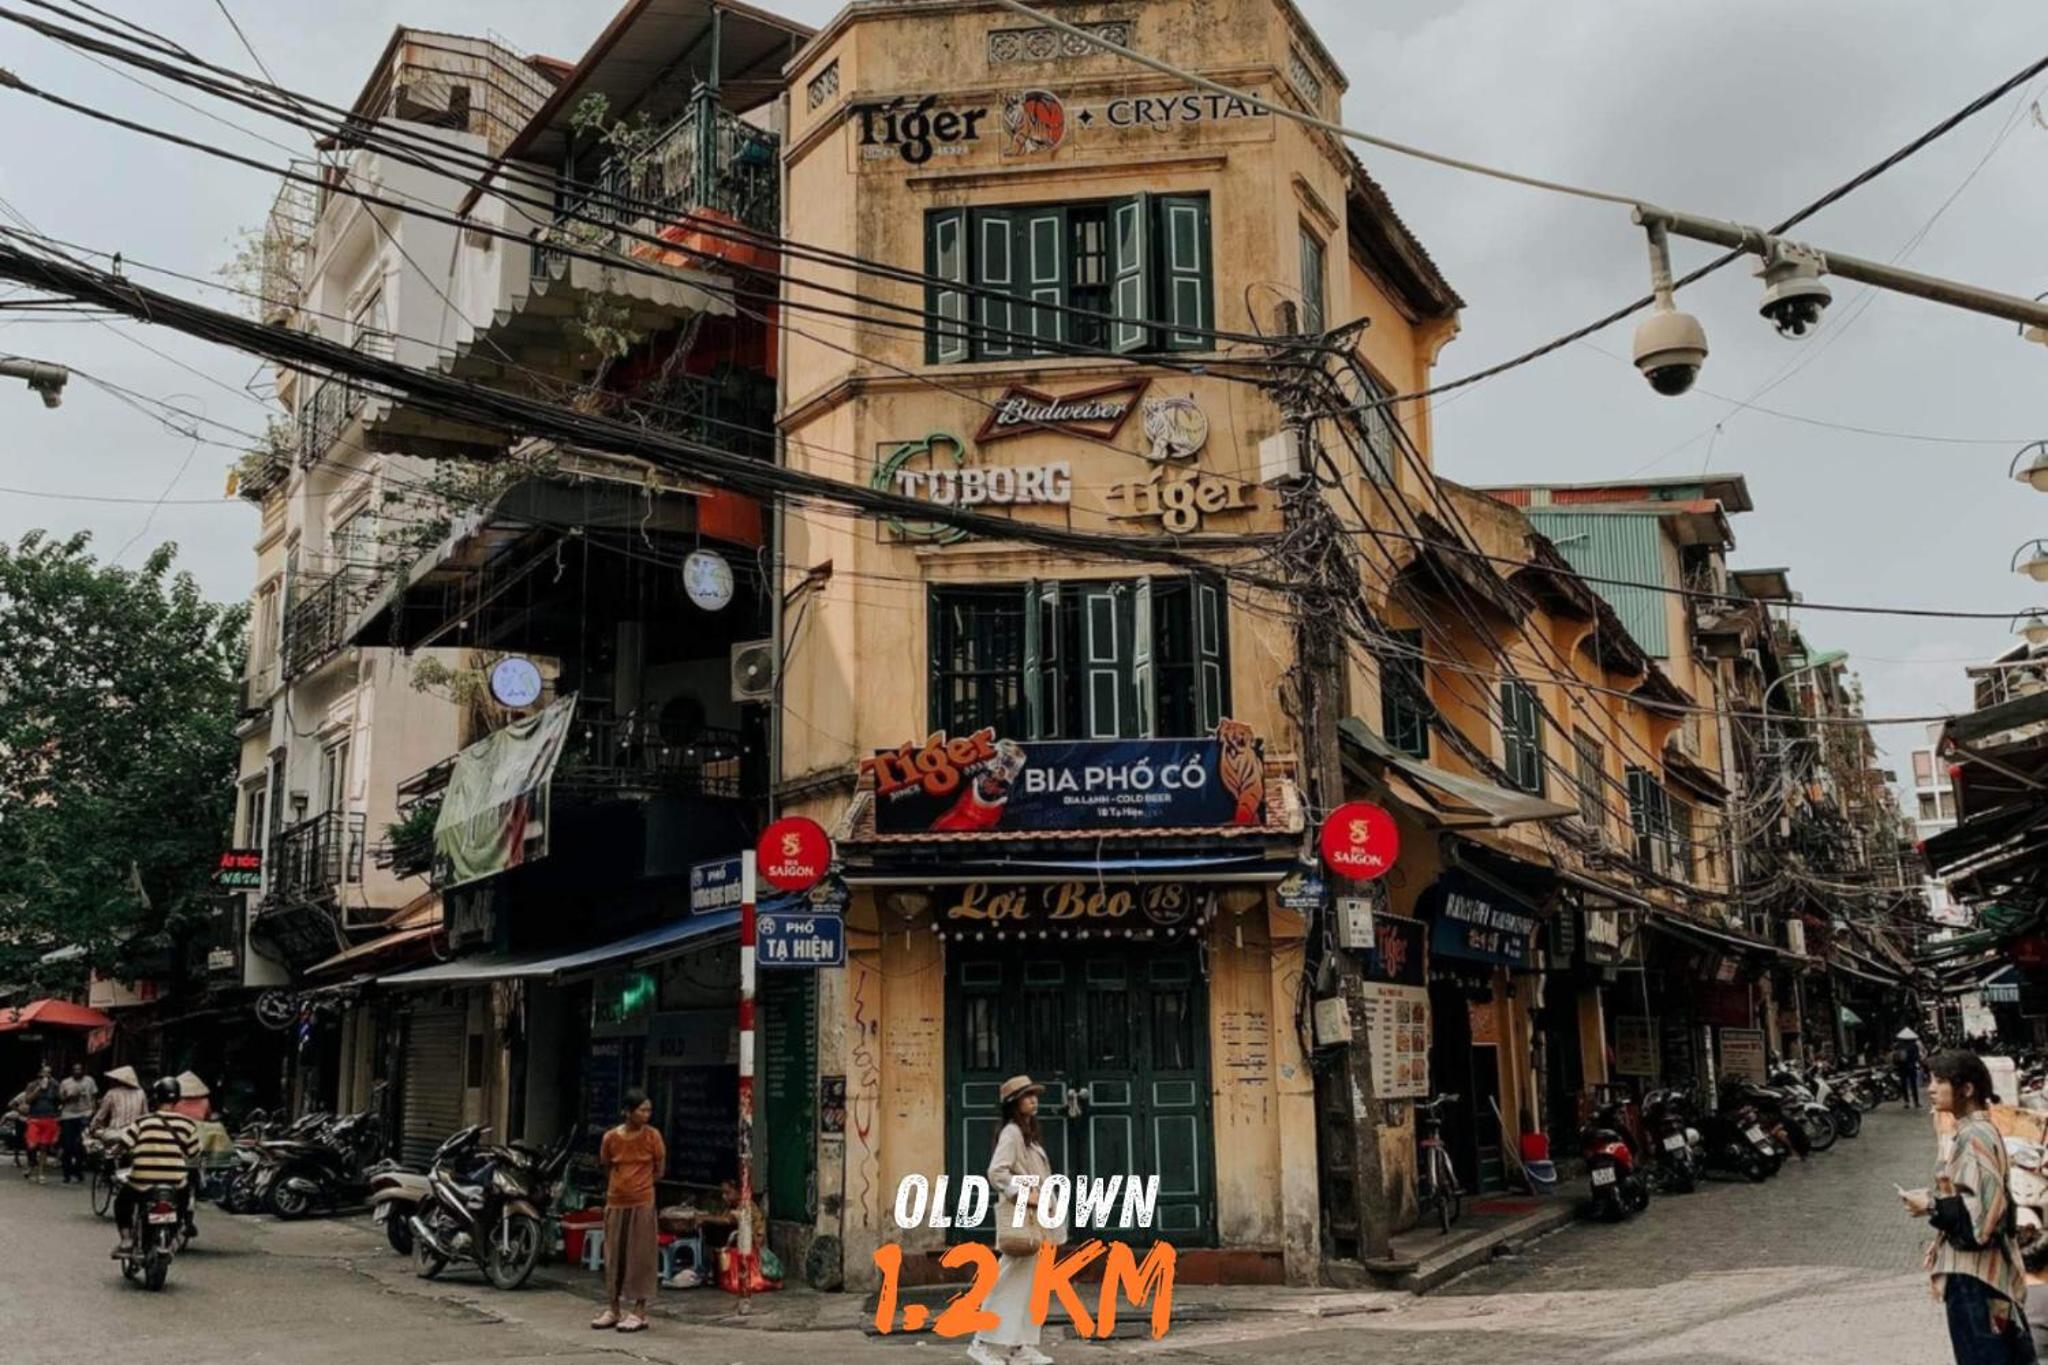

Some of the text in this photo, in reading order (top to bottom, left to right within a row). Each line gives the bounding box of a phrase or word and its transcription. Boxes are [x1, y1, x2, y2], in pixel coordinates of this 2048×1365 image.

[1107, 92, 1270, 126] CRYSTAL
[848, 94, 988, 164] Tiger
[996, 397, 1128, 425] Budweiser
[895, 461, 1071, 505] TUBORG
[1107, 463, 1258, 534] Tiger
[861, 727, 996, 796] Tiger
[1025, 768, 1079, 793] BIA
[1085, 756, 1155, 791] PHỐ
[1160, 753, 1207, 789] CỔ
[1116, 794, 1144, 804] COLD
[768, 865, 815, 877] SAIGON
[1148, 883, 1183, 909] 18
[785, 918, 816, 934] PHỐ
[766, 935, 834, 962] TẠ HIỆN
